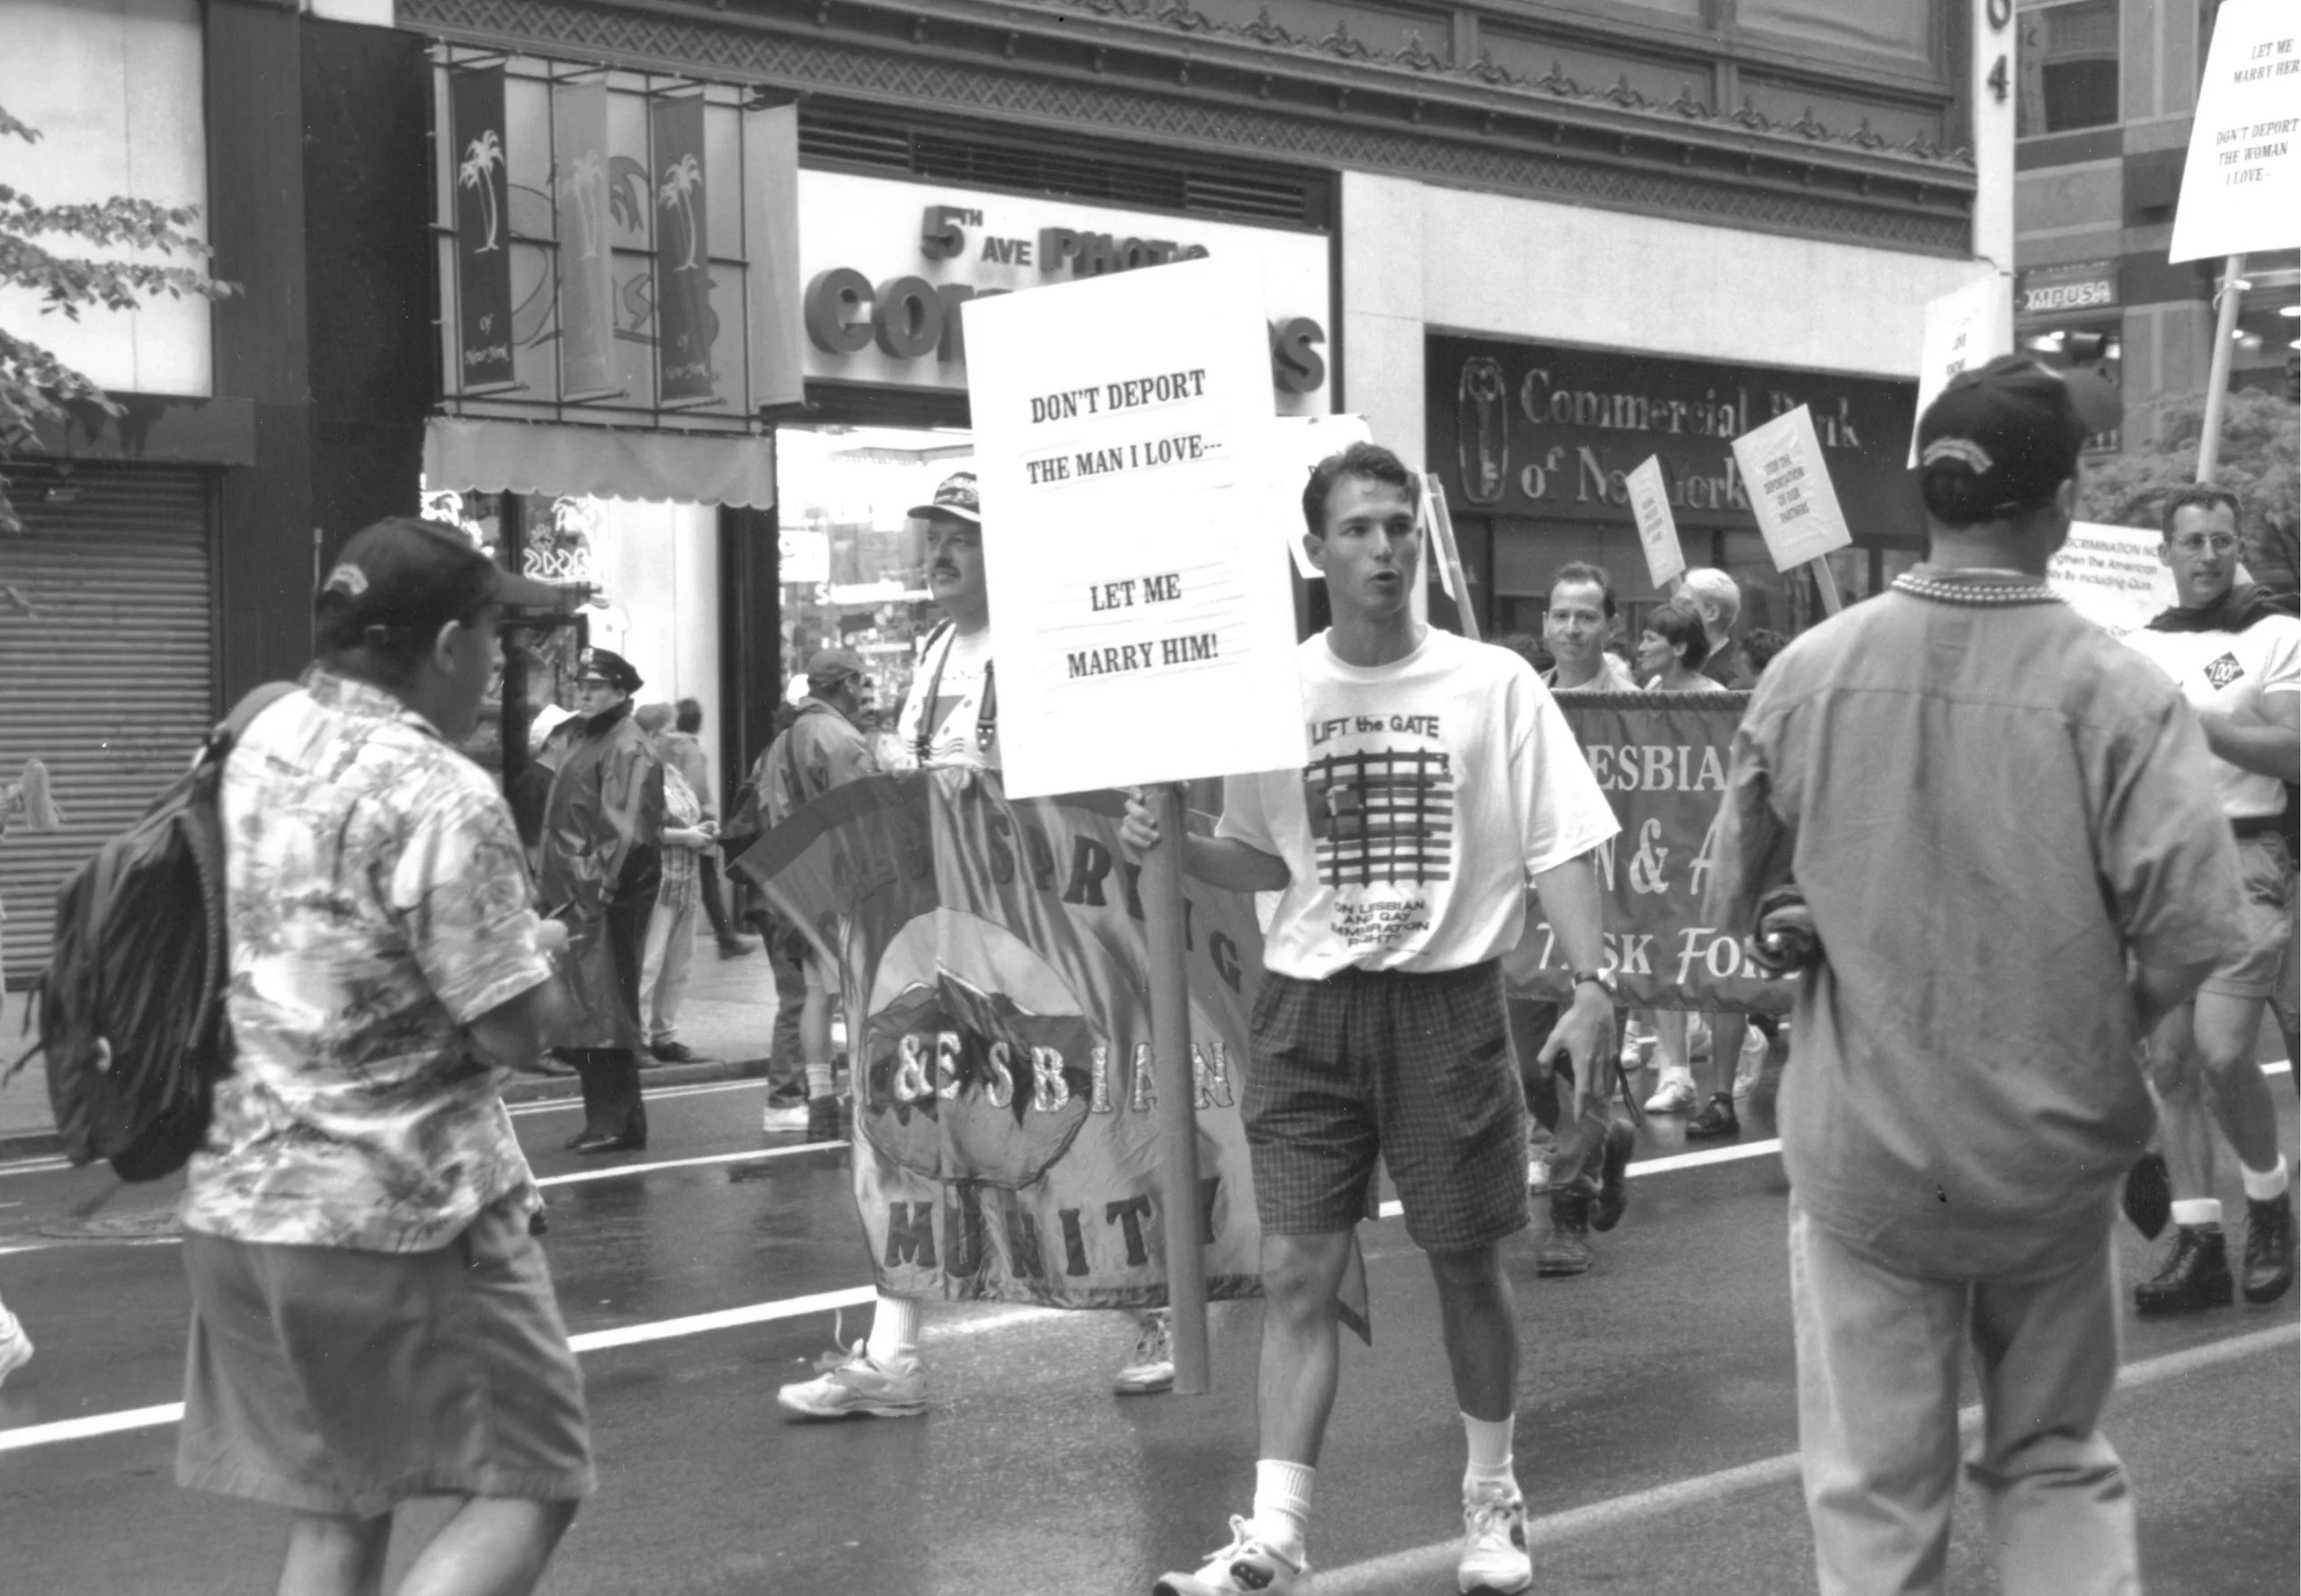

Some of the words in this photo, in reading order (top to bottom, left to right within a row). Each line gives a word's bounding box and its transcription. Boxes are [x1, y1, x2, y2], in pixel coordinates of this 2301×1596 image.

[2251, 41, 2274, 60] LET
[2276, 38, 2295, 54] ME
[2233, 64, 2274, 84] MARRY
[2216, 126, 2249, 145] DON'T
[2252, 118, 2299, 138] DEPORT
[2218, 149, 2241, 165] THE
[2244, 141, 2288, 161] WOMAN
[981, 236, 1033, 267] AVE
[1030, 387, 1100, 424] DON'T
[1106, 368, 1206, 411] DEPORT
[1521, 368, 1749, 439] Commercial
[1026, 457, 1071, 484] THE
[1075, 447, 1124, 477] MAN
[1130, 444, 1139, 468] I
[1521, 446, 1566, 500] of
[1576, 445, 1629, 505] Ne
[1089, 579, 1136, 612] LET
[1142, 572, 1182, 604] ME
[1067, 642, 1154, 678] MARRY
[1160, 633, 1219, 665] HIM!
[1311, 716, 1351, 747] LIFT
[1355, 715, 1384, 733] the
[1390, 714, 1439, 740] GATE
[1586, 744, 1737, 792] ESBIA
[1536, 922, 1655, 974] TSK
[937, 1030, 1234, 1113] ESBIAN
